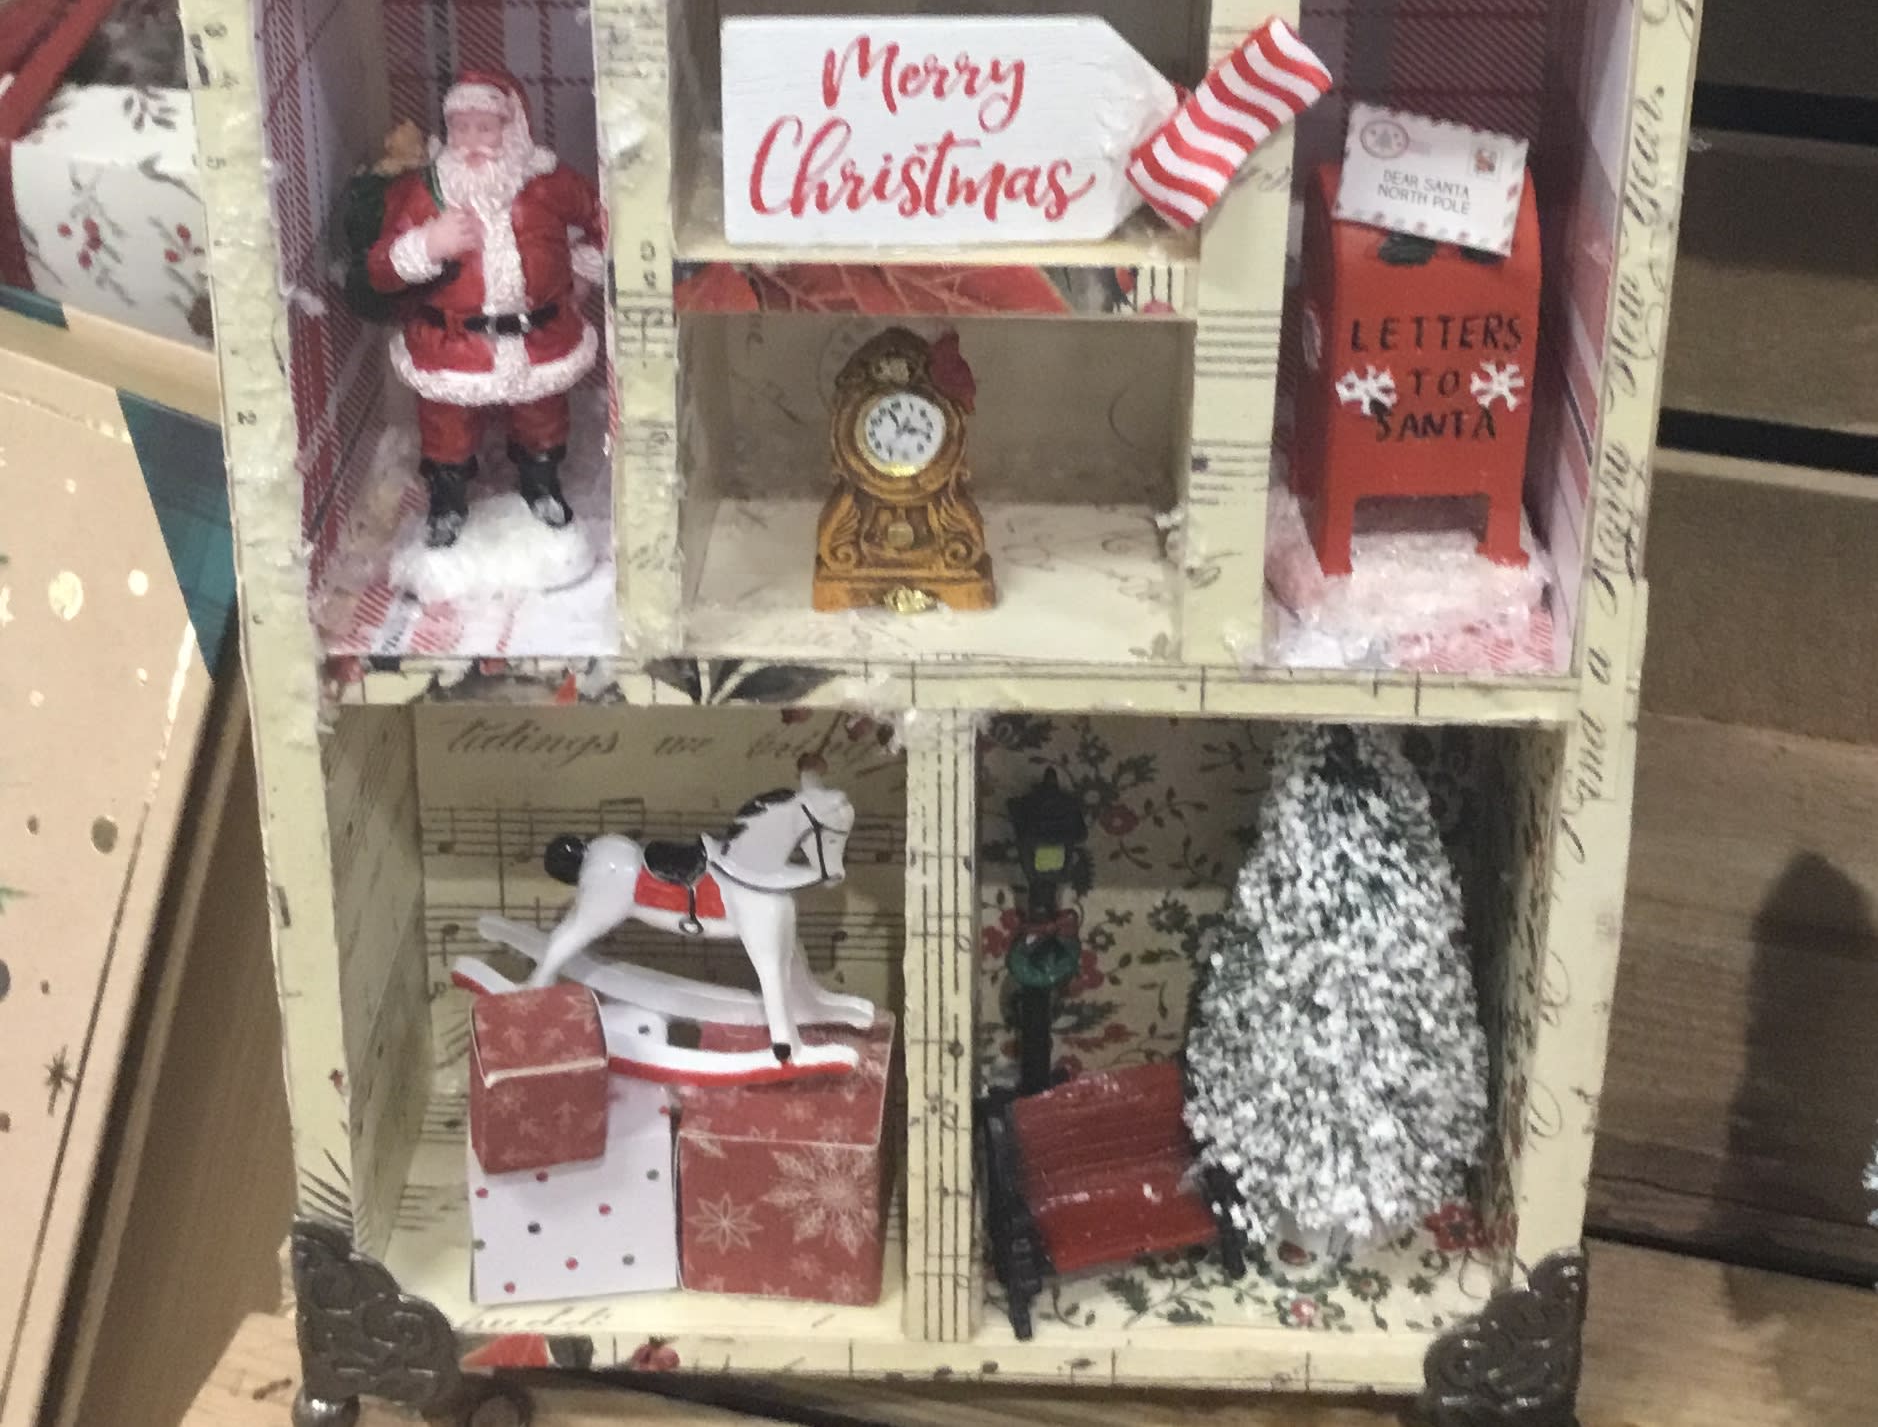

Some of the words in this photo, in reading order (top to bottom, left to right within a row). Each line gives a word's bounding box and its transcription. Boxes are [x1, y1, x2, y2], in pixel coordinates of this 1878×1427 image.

[821, 34, 1026, 134] Merry
[749, 114, 1097, 223] Christmas
[1383, 169, 1419, 188] DEAR
[1424, 177, 1470, 200] SANTA
[1377, 183, 1428, 206] NORTH
[1432, 195, 1471, 216] POLE
[1351, 314, 1523, 353] LETTERS
[1410, 369, 1461, 399] TO
[1372, 402, 1498, 442] SANTA
[1586, 646, 1611, 686] a
